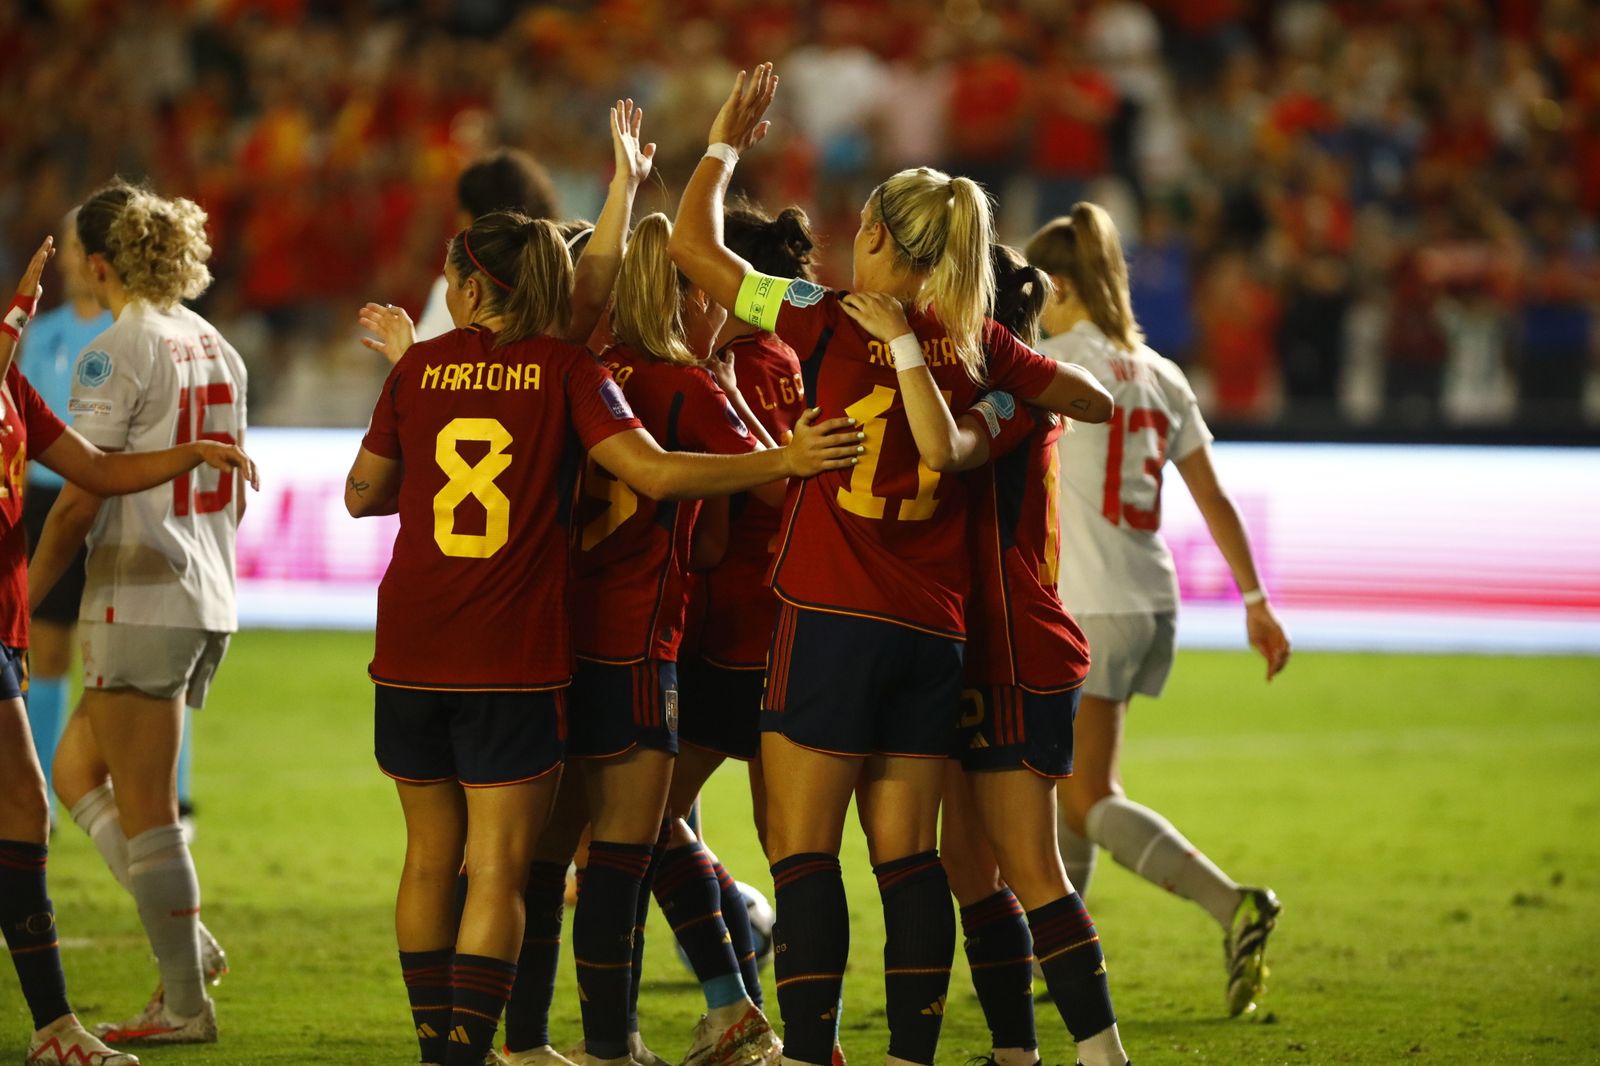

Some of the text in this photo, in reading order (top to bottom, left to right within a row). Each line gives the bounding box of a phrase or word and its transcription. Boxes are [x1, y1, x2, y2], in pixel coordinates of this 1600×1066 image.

[421, 362, 541, 391] MARIONA
[172, 384, 237, 517] 15
[433, 417, 514, 559] 8
[1103, 405, 1169, 533] 13
